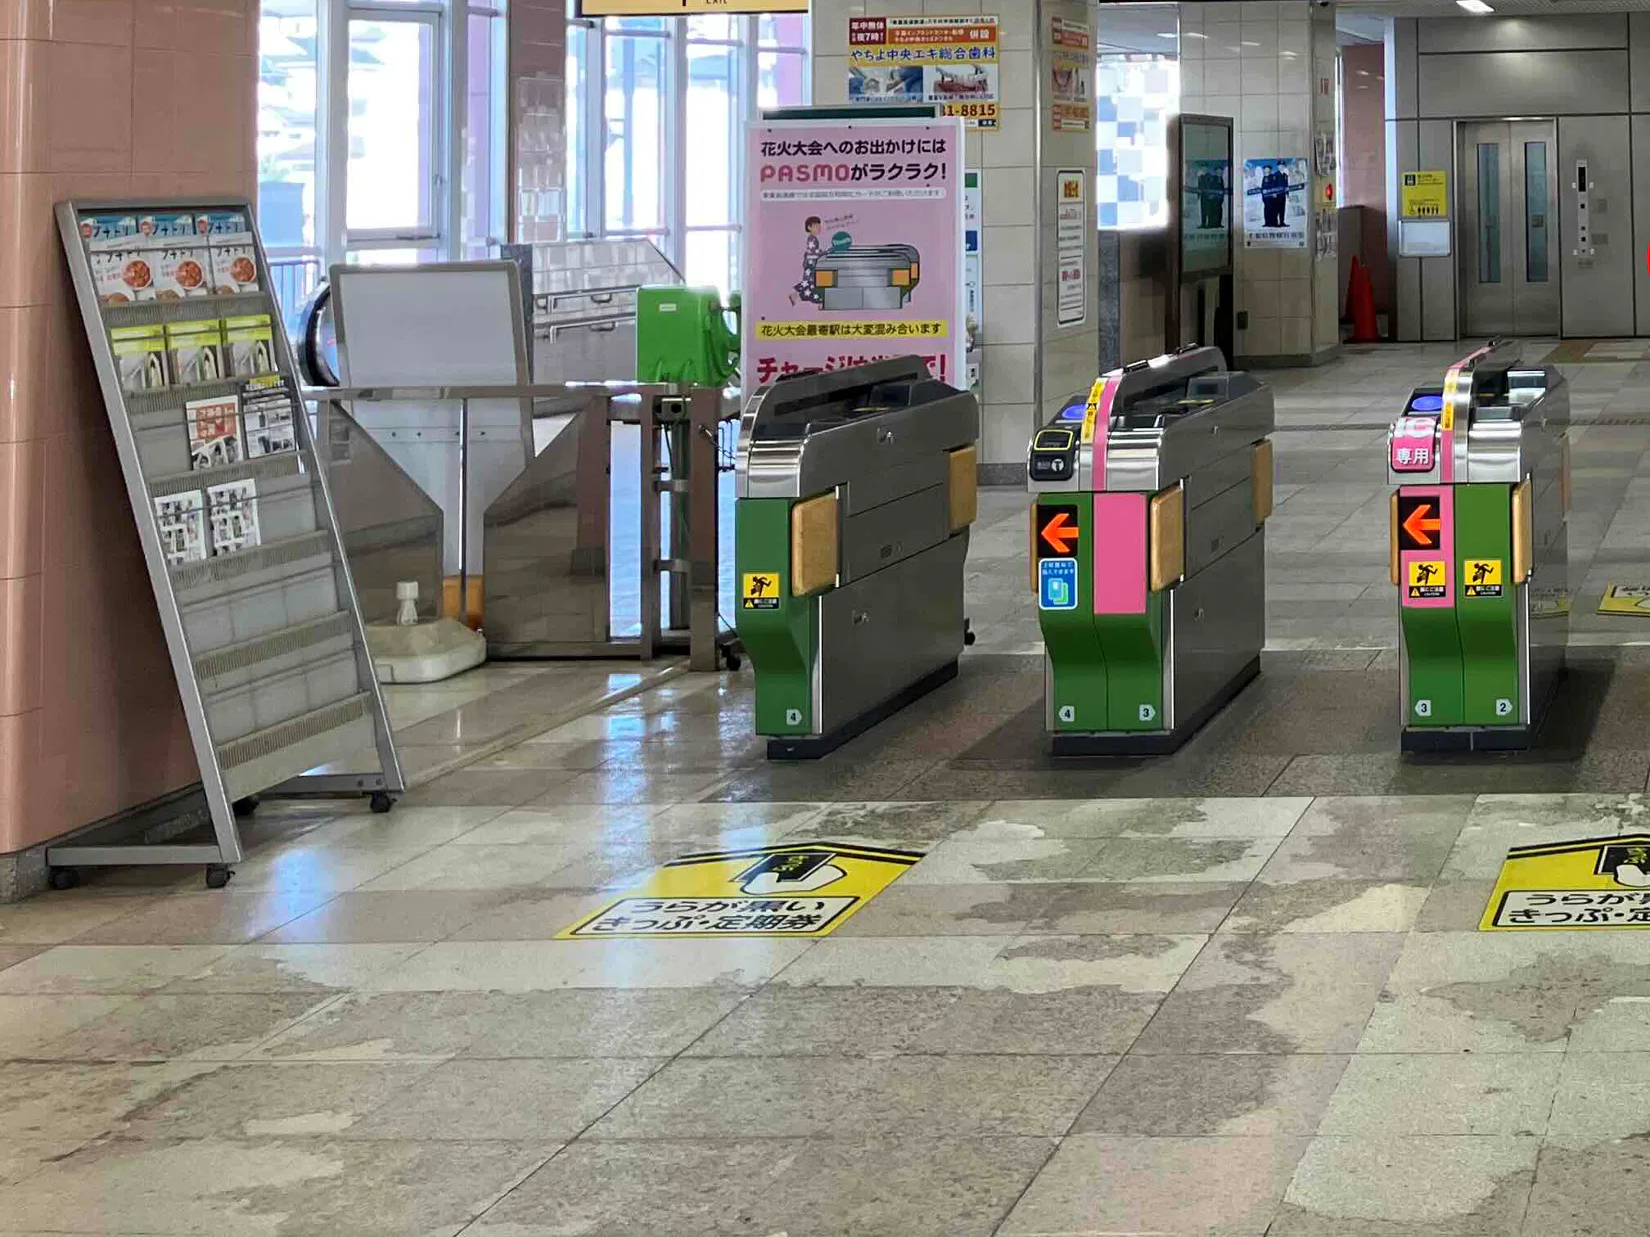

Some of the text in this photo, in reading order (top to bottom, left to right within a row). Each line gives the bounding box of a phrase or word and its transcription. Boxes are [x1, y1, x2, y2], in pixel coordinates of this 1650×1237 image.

[850, 46, 996, 61] やちよ中央エキ総合歯科
[760, 138, 947, 157] 花火大会へのお出かけには
[760, 323, 942, 338] 花火大会最寄駅は大変混み合います
[1395, 447, 1430, 465] 専用
[1064, 708, 1072, 719] 4
[1142, 707, 1150, 718] 3
[1420, 702, 1428, 714] 3
[1499, 702, 1507, 714] 2
[789, 712, 797, 723] 4
[631, 899, 826, 914] うらが黒い
[592, 913, 825, 932] きっぷ・定期券
